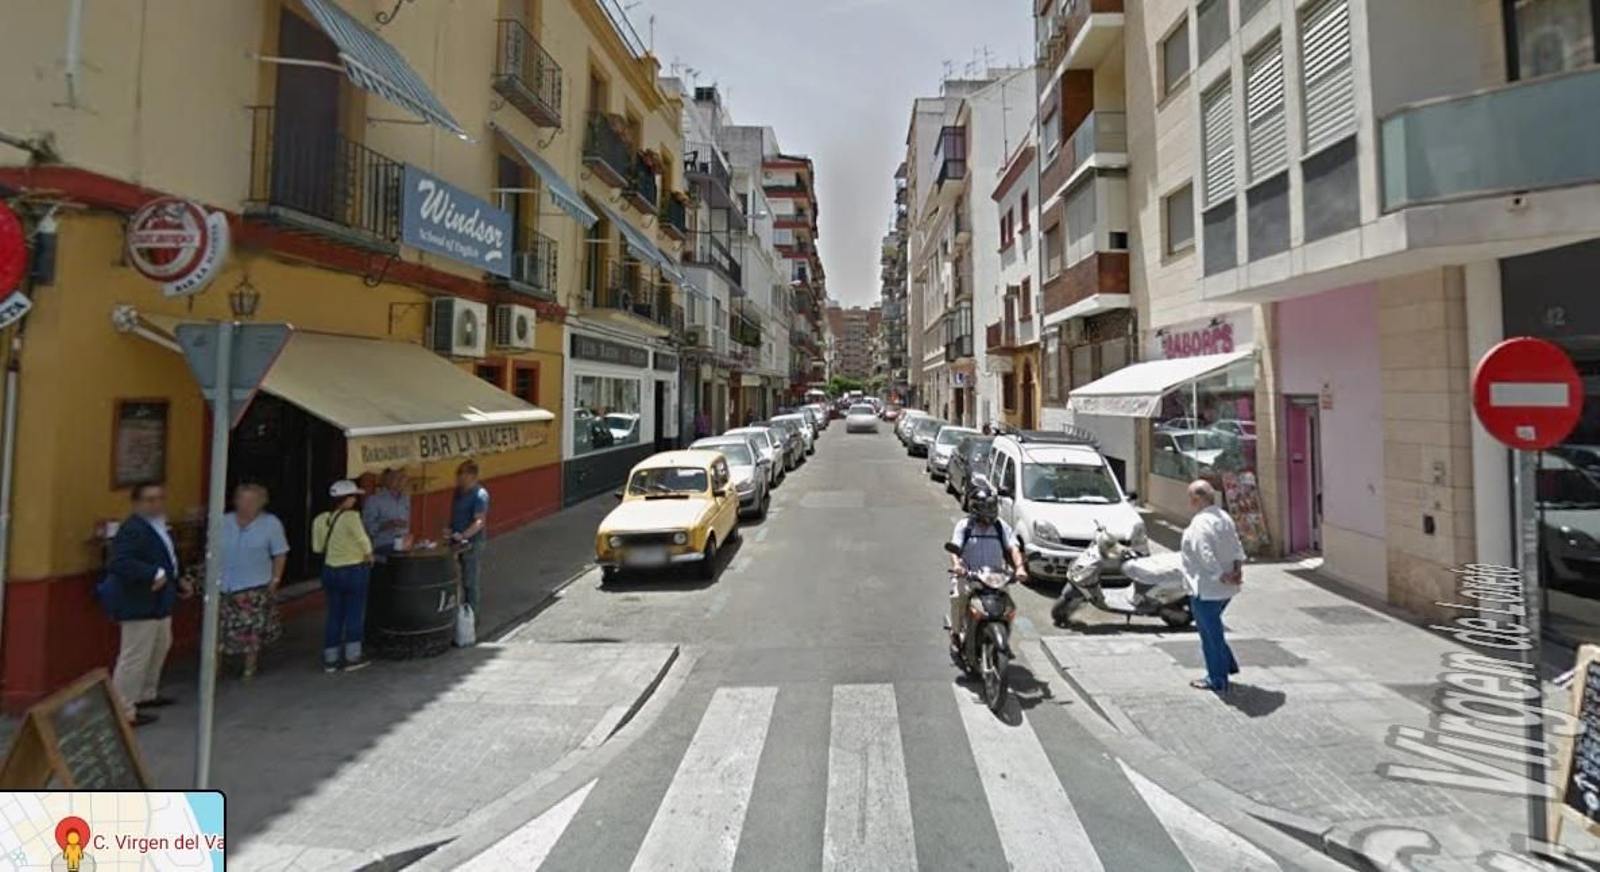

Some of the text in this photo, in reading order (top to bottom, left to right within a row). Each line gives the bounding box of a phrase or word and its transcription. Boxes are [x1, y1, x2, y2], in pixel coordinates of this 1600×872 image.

[418, 180, 503, 248] Windsor
[420, 434, 451, 458] BAR
[456, 432, 475, 452] LA
[477, 427, 520, 450] MACETA
